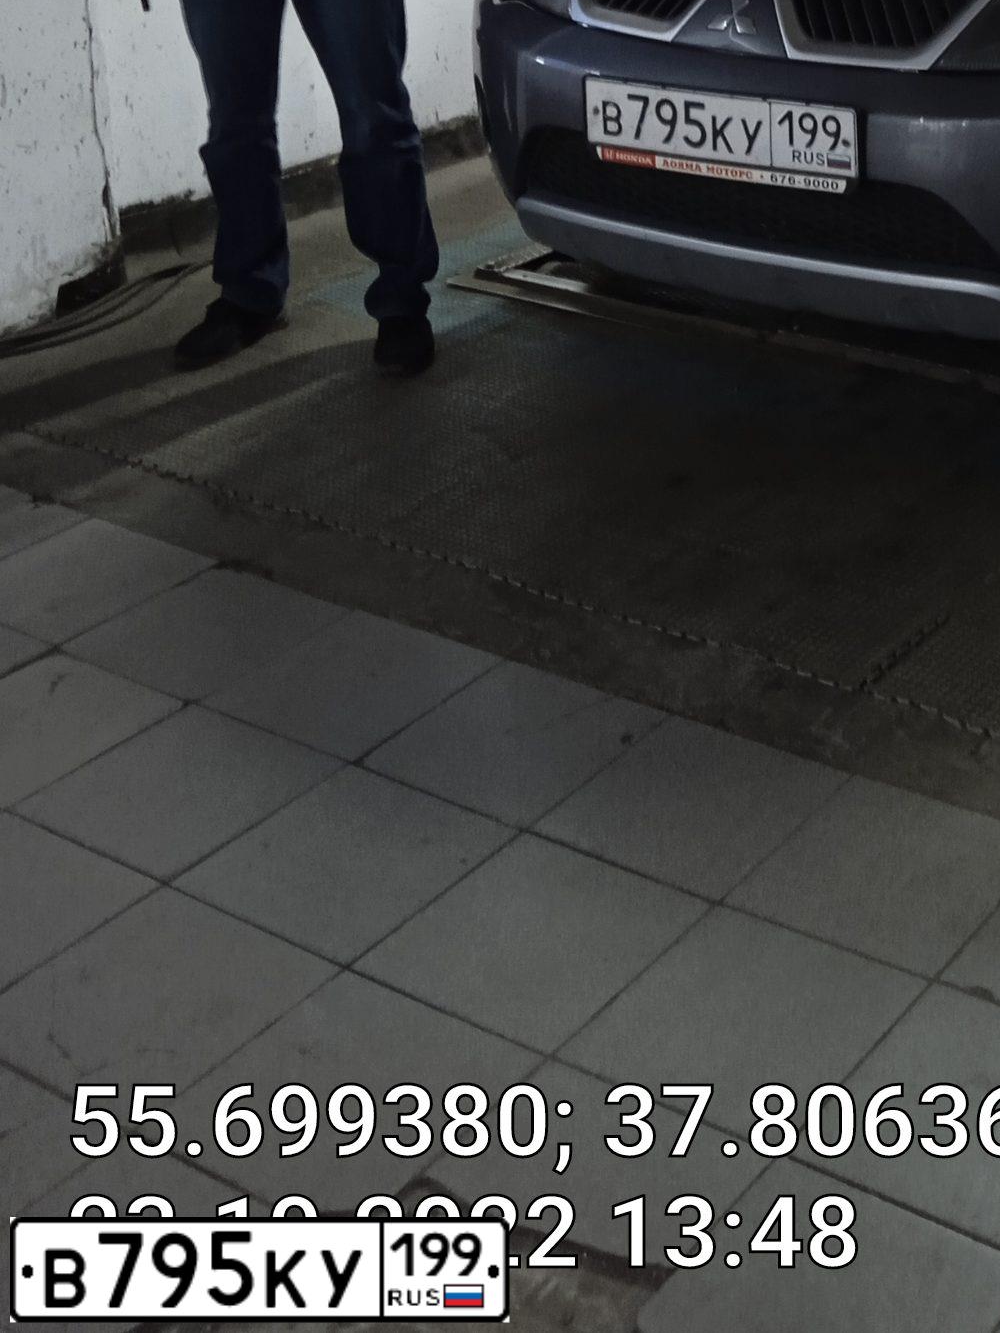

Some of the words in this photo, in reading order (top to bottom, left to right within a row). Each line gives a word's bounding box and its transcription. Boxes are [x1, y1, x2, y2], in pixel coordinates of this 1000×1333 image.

[778, 110, 842, 151] 199
[615, 153, 653, 166] HONDA
[792, 150, 825, 166] RUS
